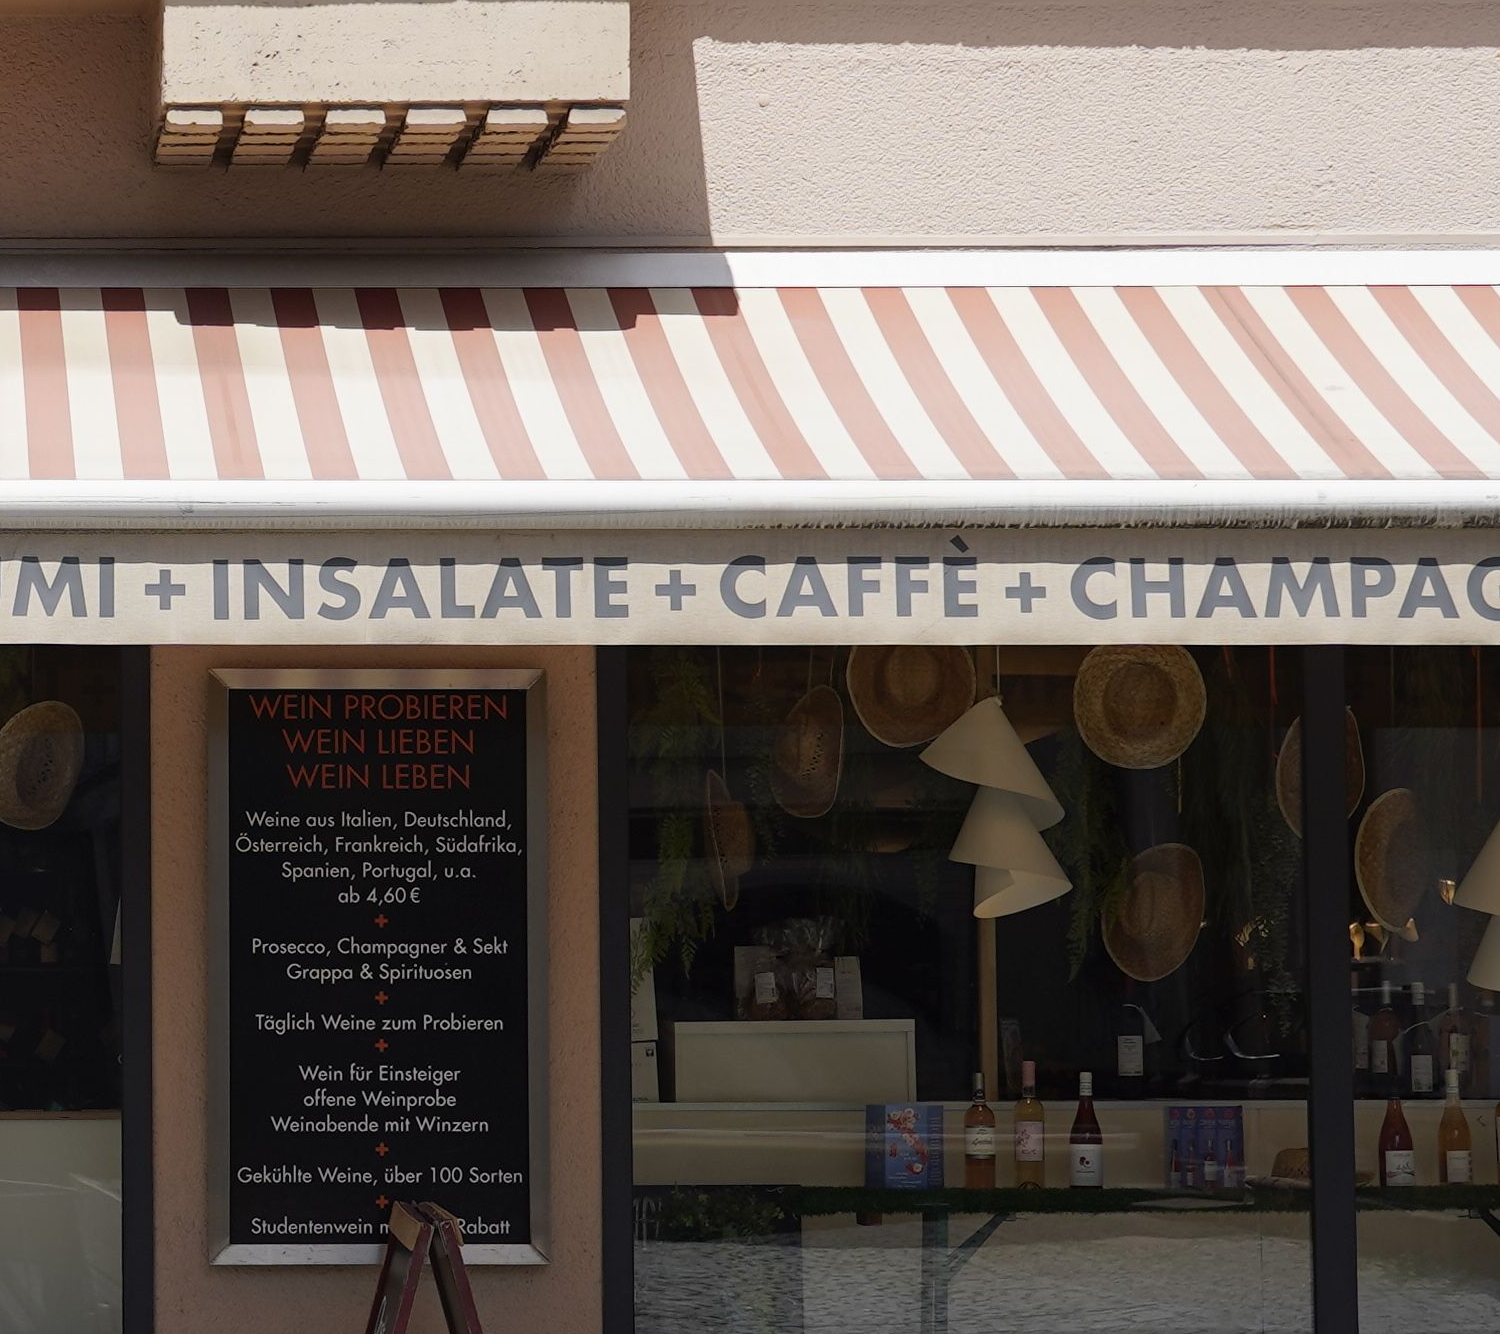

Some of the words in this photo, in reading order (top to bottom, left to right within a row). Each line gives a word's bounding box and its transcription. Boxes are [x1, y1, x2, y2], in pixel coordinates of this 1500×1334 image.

[215, 559, 626, 619] INSALATE
[722, 536, 976, 617] CAFFÈ
[248, 694, 332, 720] WEIN
[344, 694, 508, 720] PROBIEREN
[281, 728, 366, 755] WEIN
[378, 729, 474, 755] LIEBEN
[286, 763, 370, 790] WEIN
[382, 763, 470, 790] LEBEN
[245, 810, 301, 828] Weine
[305, 816, 335, 828] aus
[341, 809, 398, 830] Italien,
[404, 809, 512, 831] Deutschland,
[235, 832, 329, 856] Österreich,
[335, 834, 429, 856] Frankreich,
[435, 834, 522, 856] Südafrika,
[252, 937, 331, 957] Prosecco,
[337, 935, 448, 959] Champagner
[453, 937, 468, 955] &
[472, 935, 509, 955] Sekt
[255, 1011, 315, 1036] Täglich
[320, 1013, 376, 1031] Weine
[381, 1019, 417, 1031] zum
[423, 1012, 504, 1031] Probieren
[298, 1064, 343, 1082] Wein
[349, 1062, 373, 1082] für
[379, 1064, 461, 1087] Einsteiger
[303, 1087, 357, 1107] offene
[361, 1088, 457, 1112] Weinprobe
[270, 1113, 379, 1133] Weinabende
[384, 1116, 411, 1132] mit
[415, 1115, 489, 1133] Winzern
[237, 1164, 313, 1184] Gekühlte
[317, 1166, 378, 1187] Weine,
[384, 1164, 423, 1184] über
[430, 1166, 463, 1184] 100
[469, 1166, 523, 1184] Sorten
[250, 1217, 373, 1235] Studentenwein
[457, 1217, 511, 1235] Rabatt
